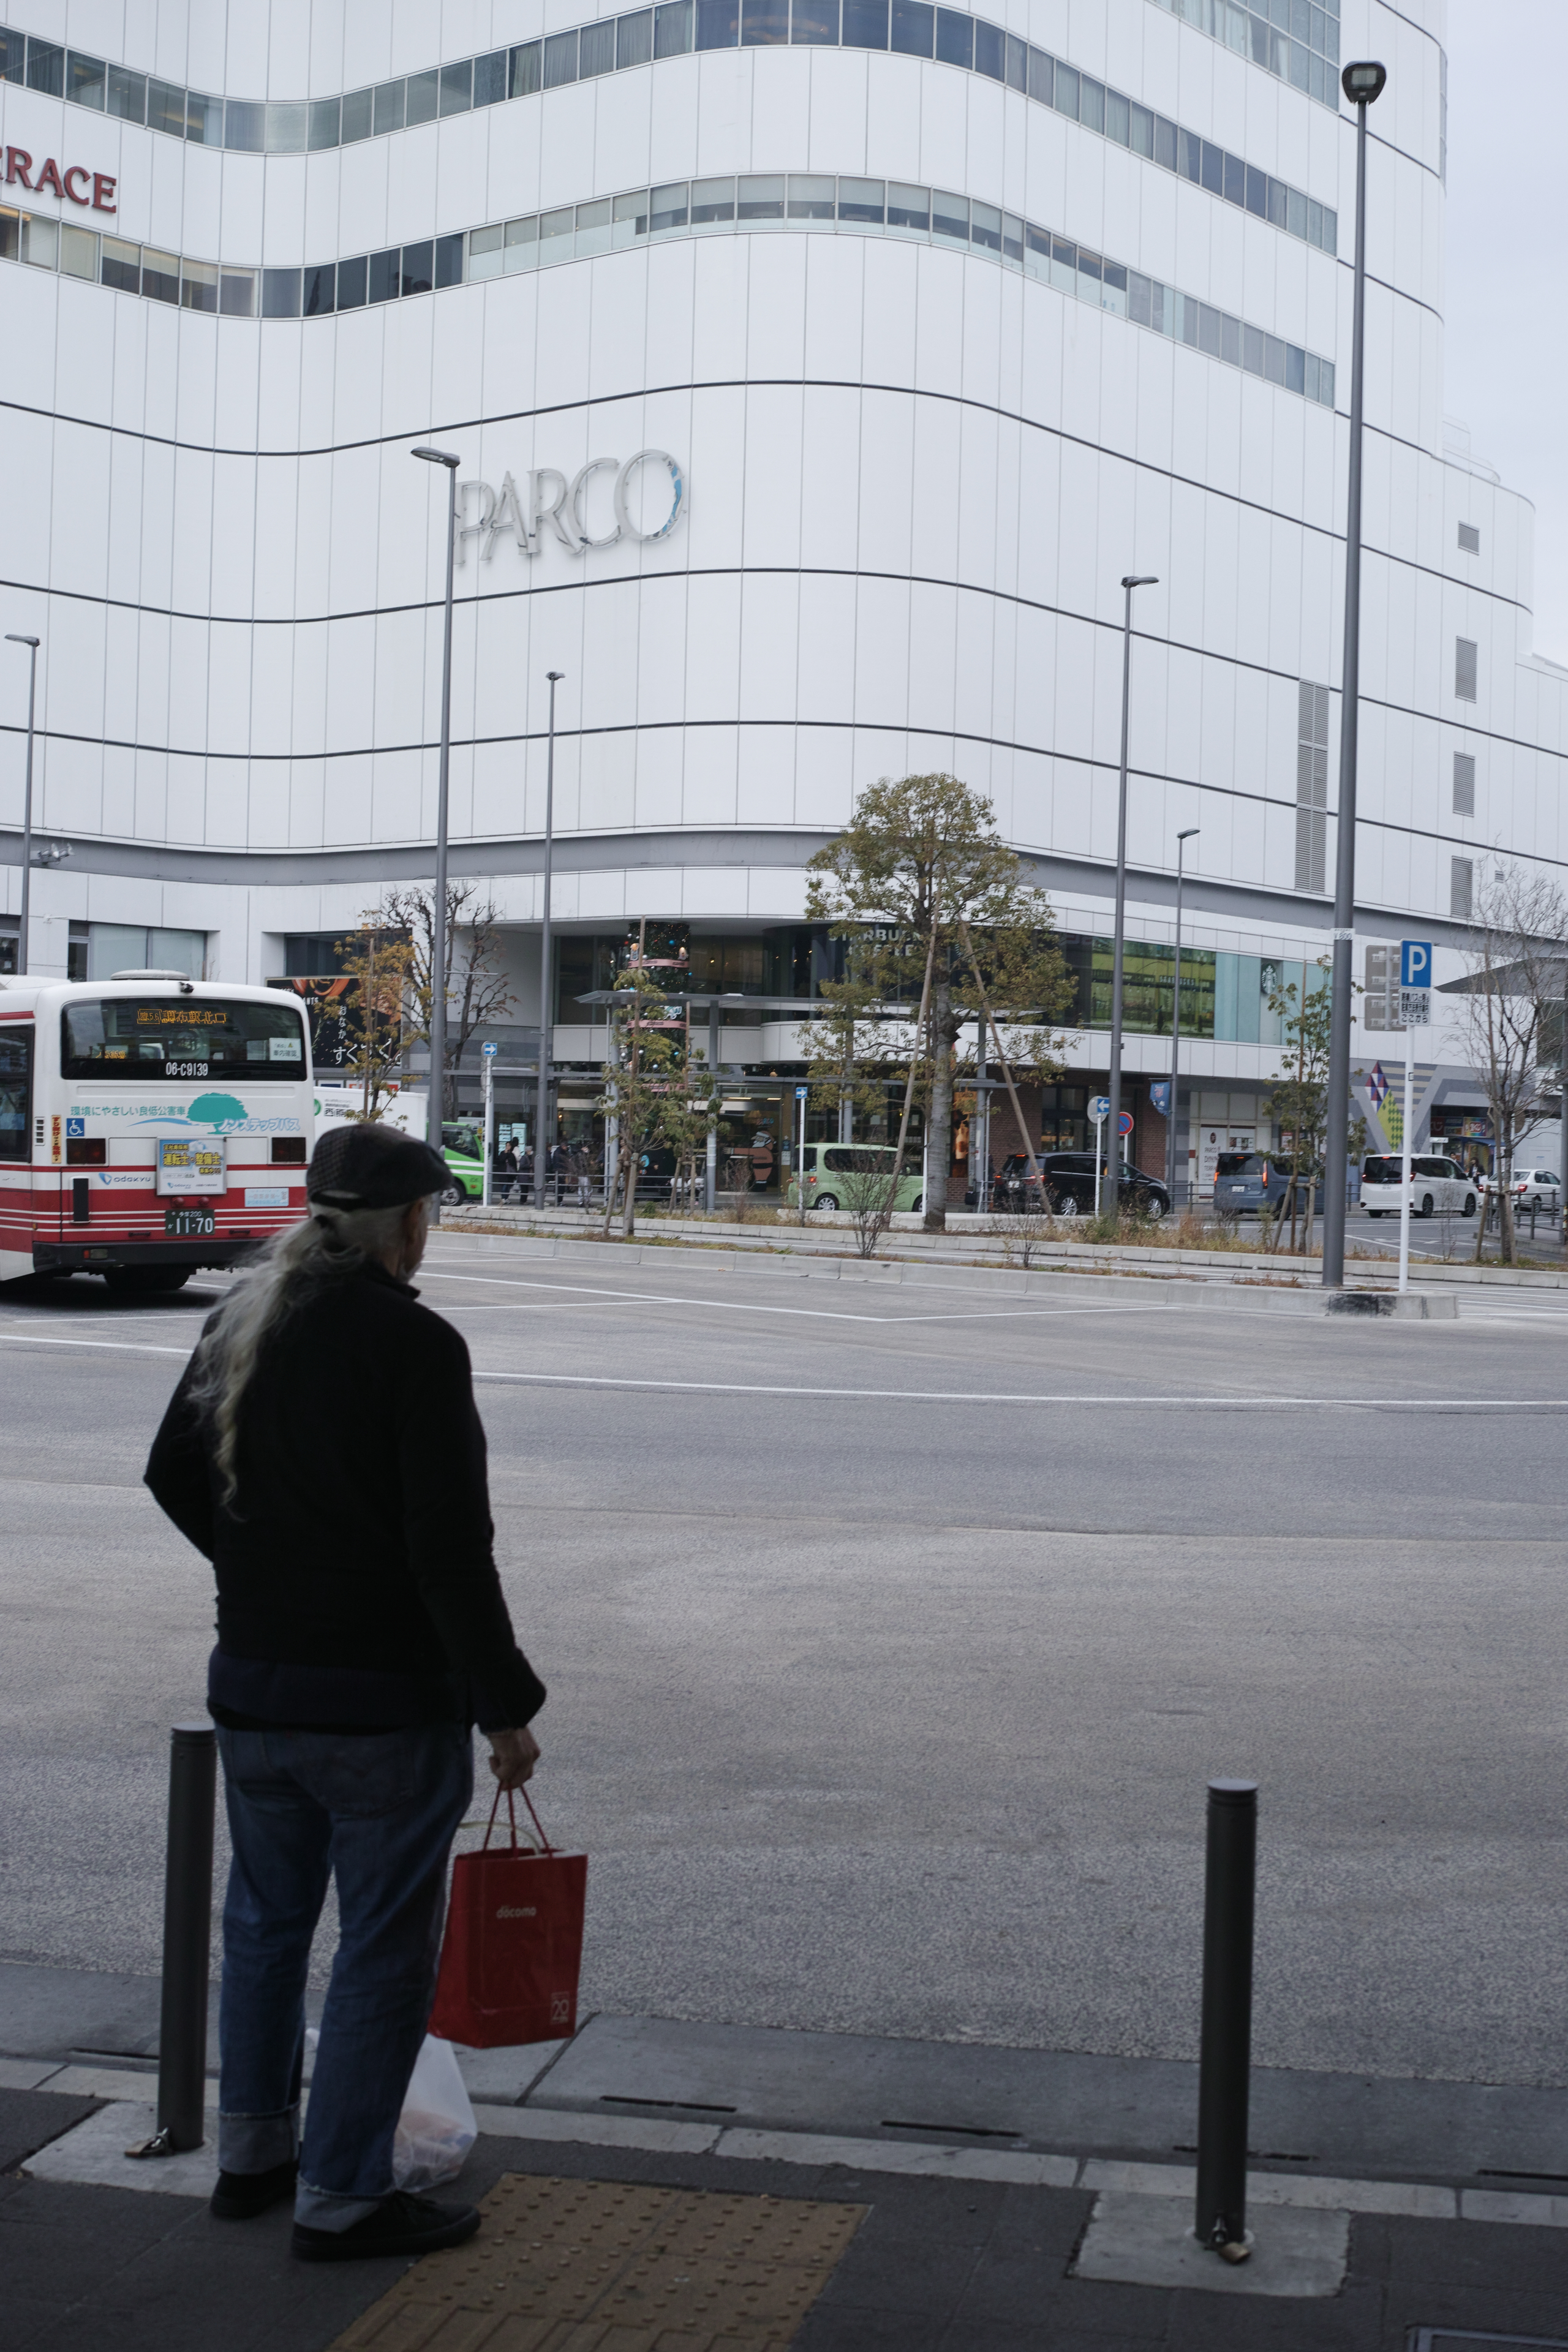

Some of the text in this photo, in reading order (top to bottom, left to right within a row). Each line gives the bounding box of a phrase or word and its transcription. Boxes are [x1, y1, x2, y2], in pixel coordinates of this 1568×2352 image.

[0, 146, 116, 213] RACE
[453, 449, 684, 565] PARCO
[1408, 945, 1427, 983] P
[161, 1010, 227, 1024] 調布駅北口
[1401, 1014, 1428, 1023] ここから
[165, 1061, 209, 1076] 06-C9139
[218, 1118, 300, 1131] ノンステップバス
[163, 1152, 221, 1167] 運転士・整備士
[176, 1218, 213, 1234] 11-70
